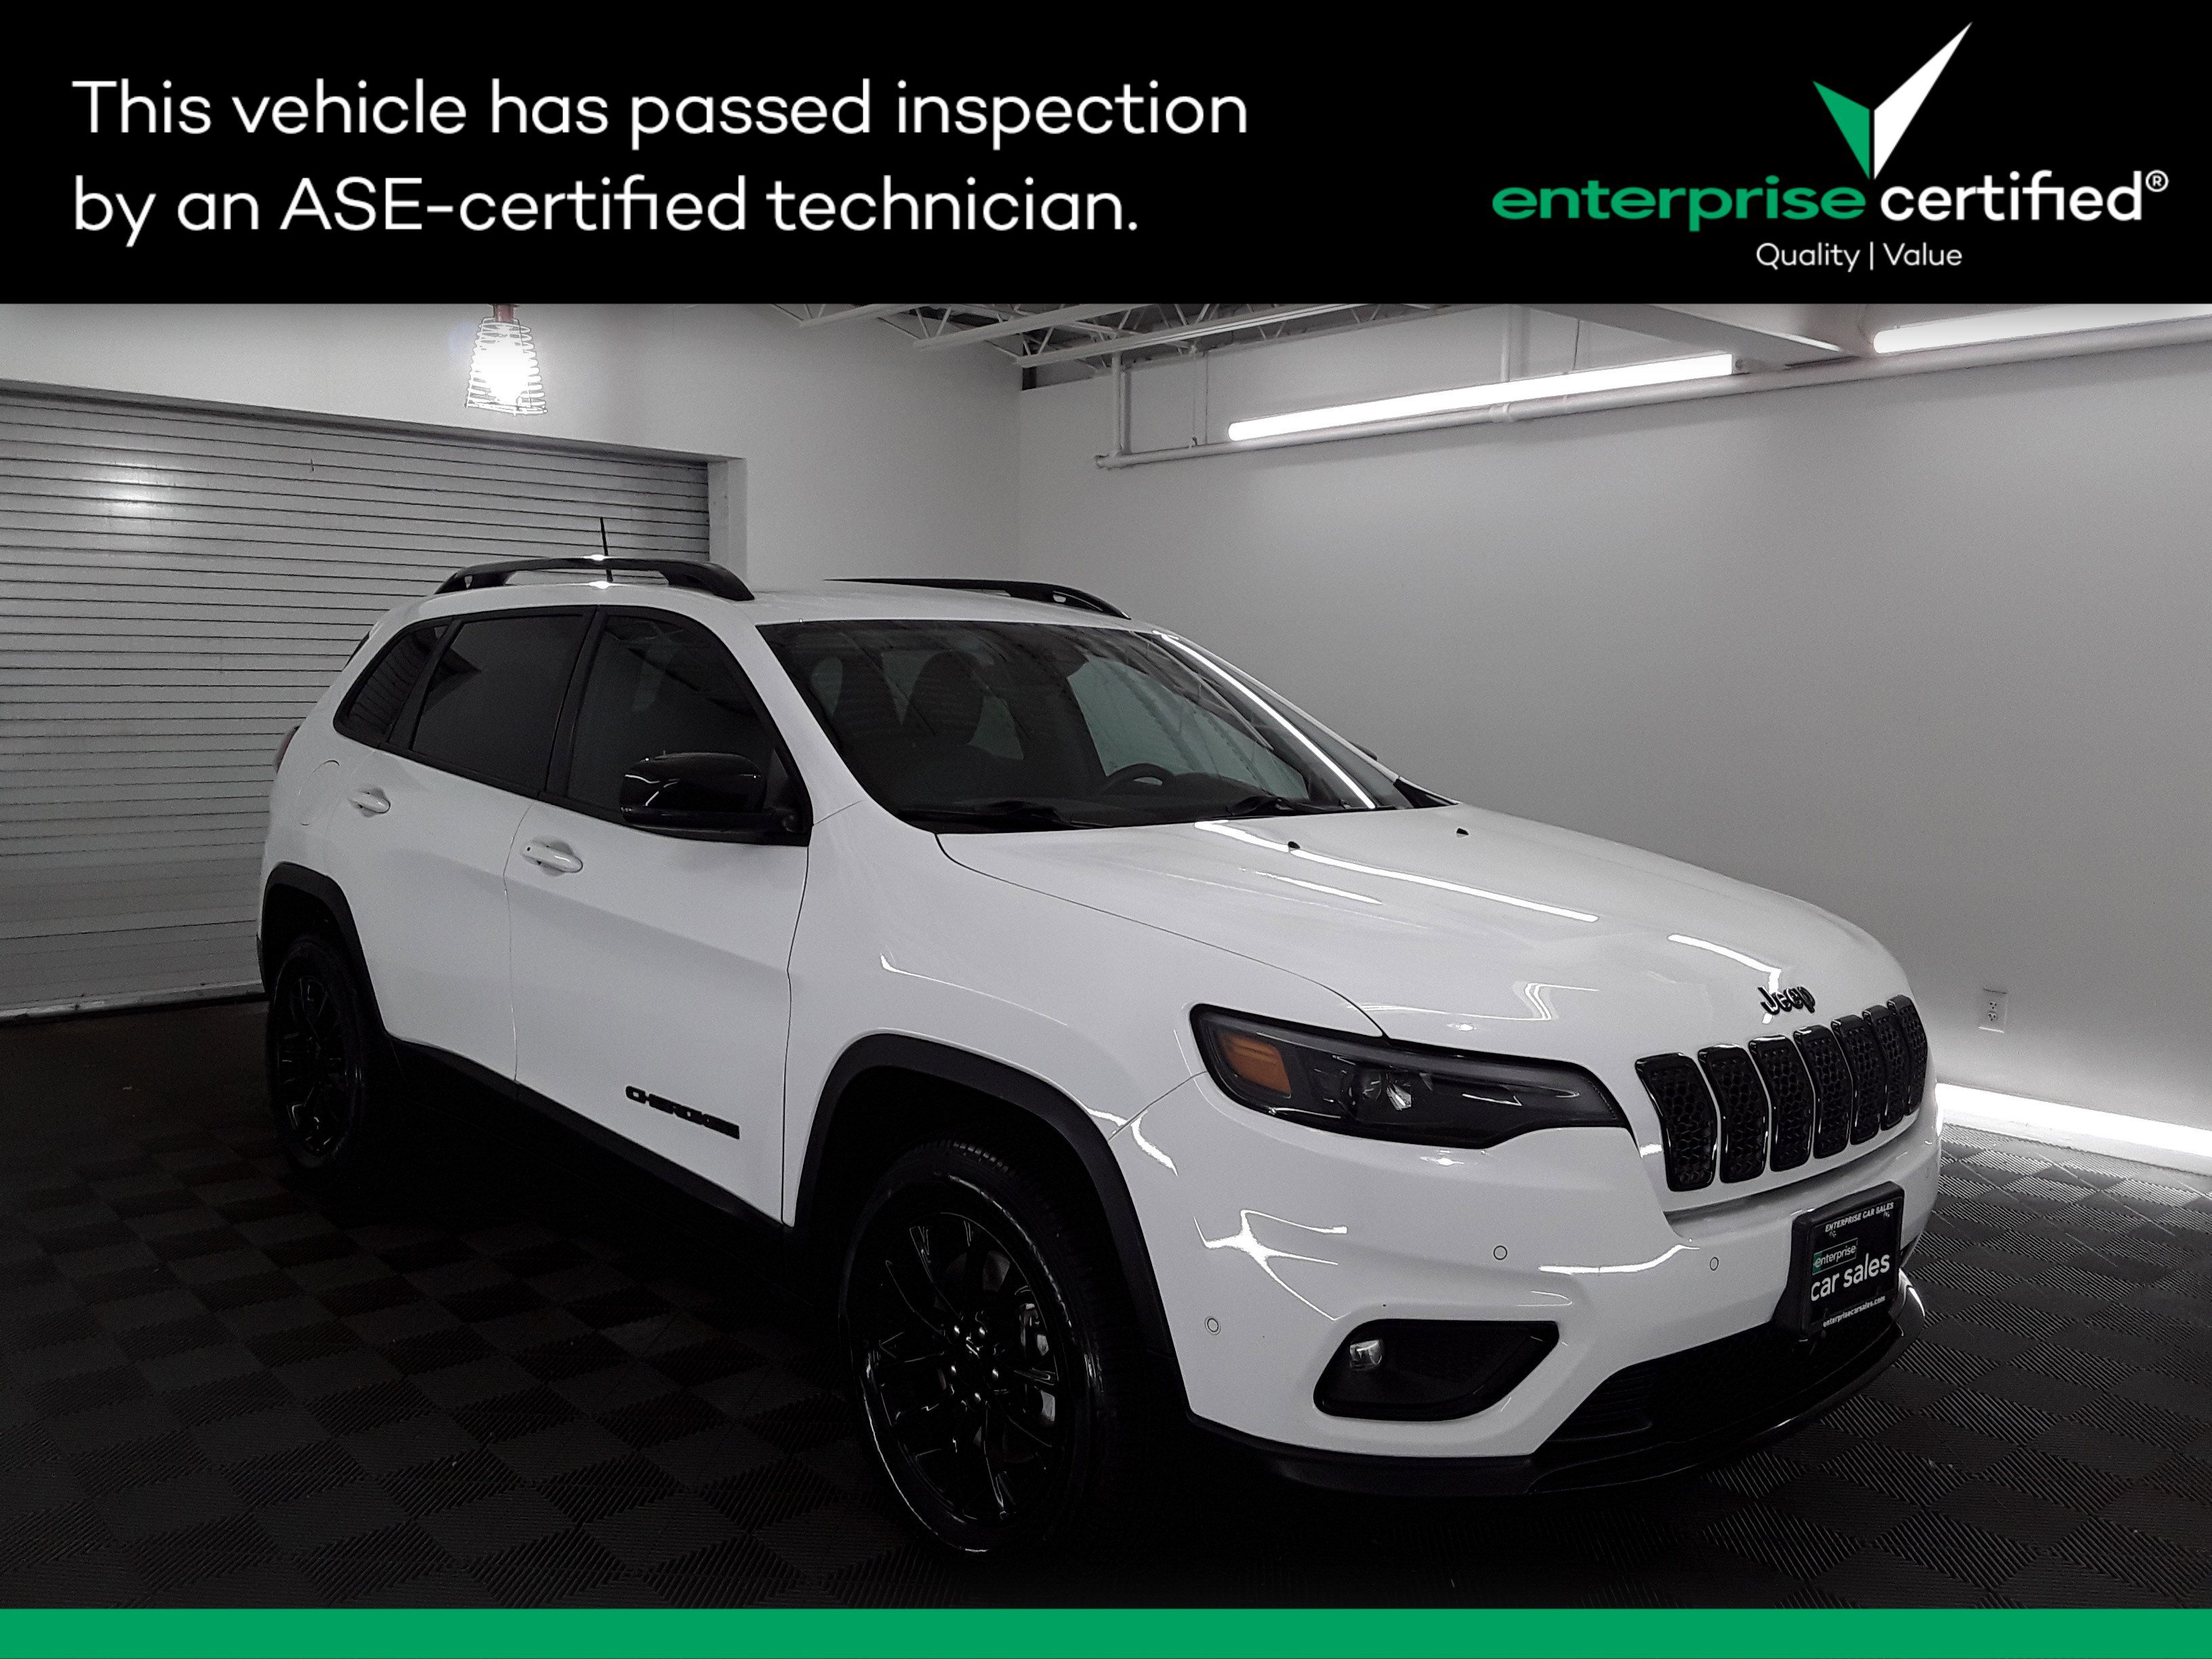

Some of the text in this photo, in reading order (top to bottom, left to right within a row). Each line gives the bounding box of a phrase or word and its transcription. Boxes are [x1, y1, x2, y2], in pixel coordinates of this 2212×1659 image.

[1757, 986, 1816, 1015] Jeep
[1824, 1202, 1894, 1232] ENTERPRISE CAR SALES
[1814, 1245, 1857, 1268] enterprise
[1811, 1253, 1890, 1301] car sales
[1823, 1296, 1885, 1327] enterprisecarsales.com
